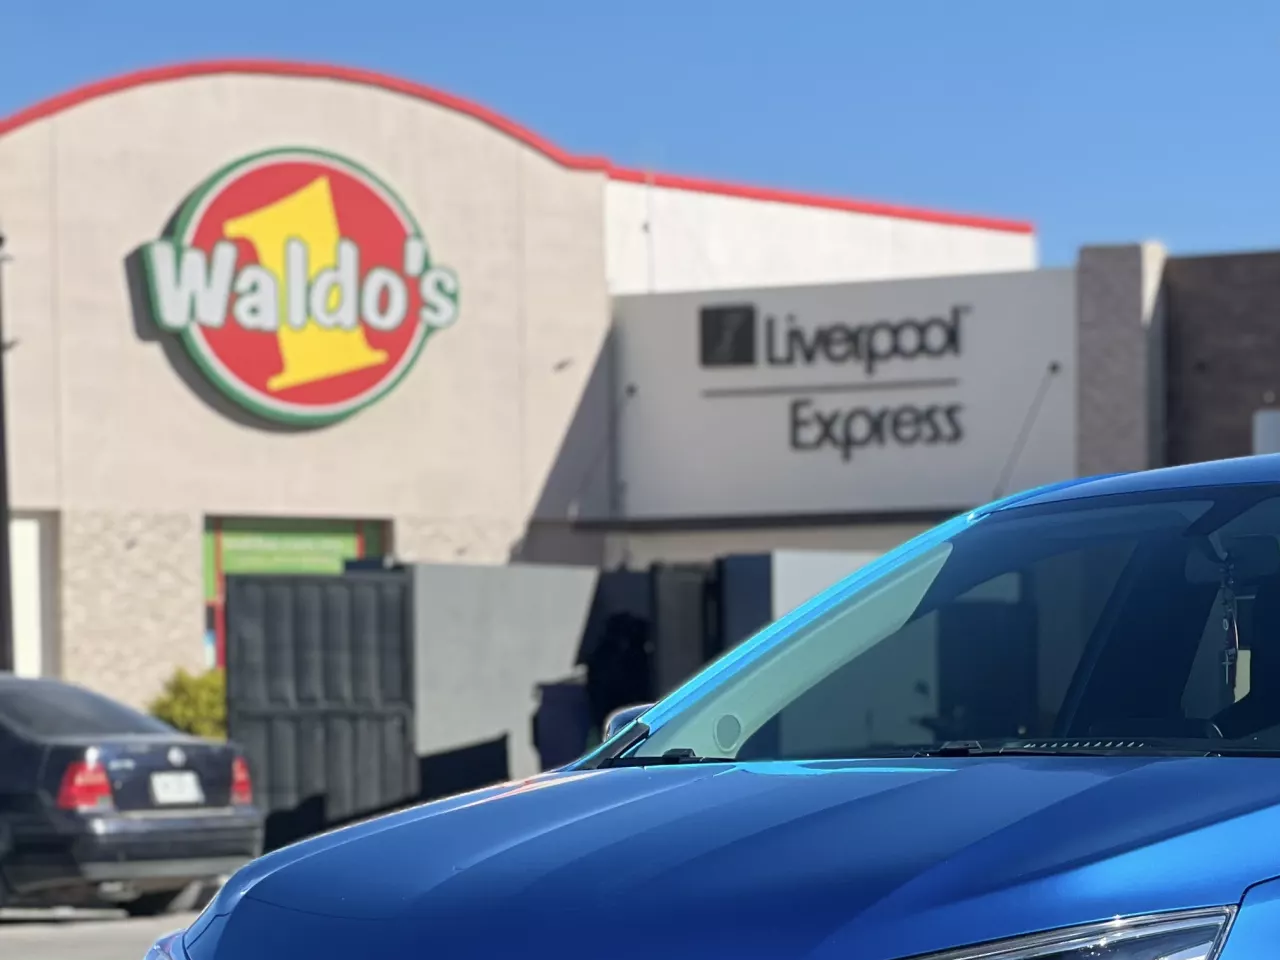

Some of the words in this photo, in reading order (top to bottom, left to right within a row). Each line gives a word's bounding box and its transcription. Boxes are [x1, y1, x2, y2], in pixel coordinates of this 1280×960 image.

[146, 233, 459, 332] Waldo's
[764, 305, 963, 377] Liverpool
[788, 398, 963, 463] Express
